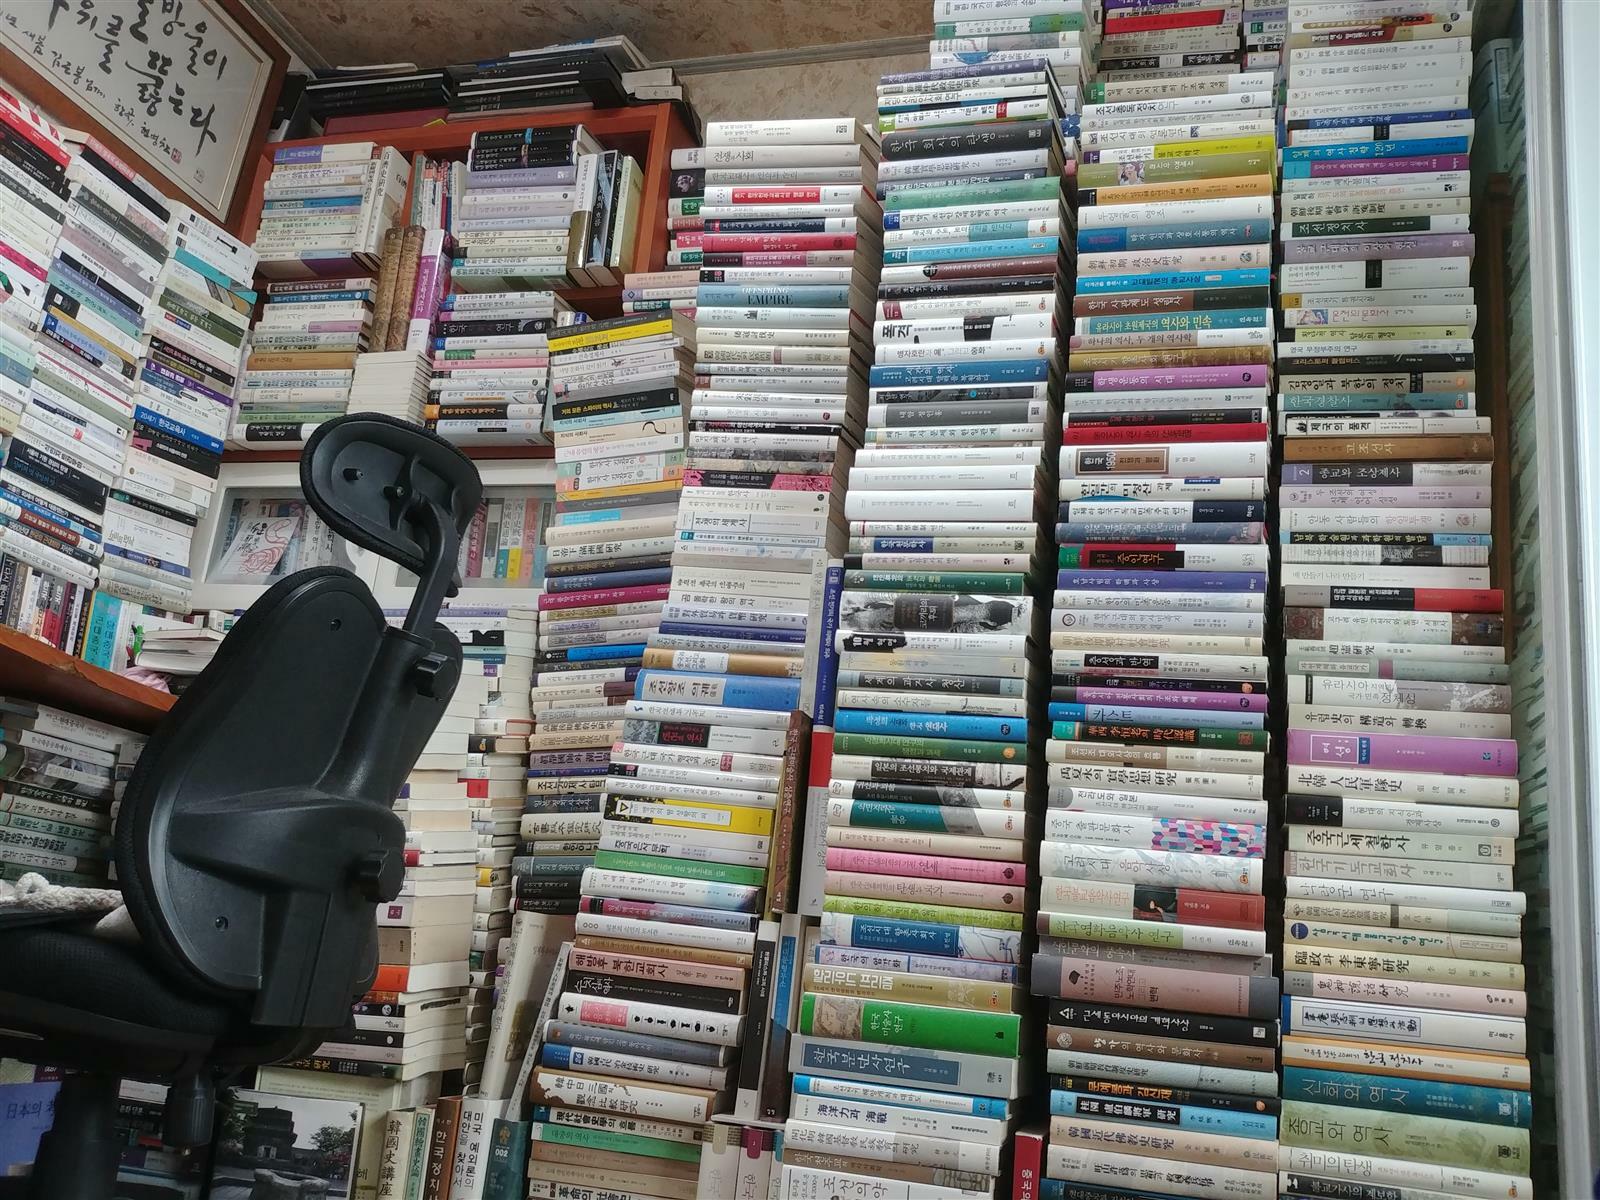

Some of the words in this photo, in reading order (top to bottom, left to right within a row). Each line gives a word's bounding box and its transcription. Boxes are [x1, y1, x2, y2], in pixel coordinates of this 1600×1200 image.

[736, 151, 754, 162] 사회
[1300, 221, 1368, 234] 조선정치사
[748, 295, 794, 305] EMPIRE
[1095, 322, 1122, 333] 유라시아
[1125, 319, 1158, 330] 초원제국의
[1161, 317, 1190, 330] 역사와
[1193, 315, 1212, 329] 민속
[1088, 337, 1112, 346] 하나의
[1115, 335, 1134, 345] 역사,
[1136, 335, 1144, 344] 두
[1148, 334, 1165, 343] 개의
[1167, 334, 1192, 343] 역사학
[1289, 379, 1336, 391] 김정일과
[1341, 378, 1377, 389] 북한의
[1382, 377, 1408, 388] 정치
[158, 417, 186, 436] 한국교육사
[1311, 422, 1344, 432] 제국의
[1348, 422, 1372, 431] 품격
[1346, 442, 1396, 455] 고조선사
[1106, 451, 1116, 471] 1950
[1319, 467, 1353, 478] 종교와
[1356, 467, 1400, 479] 조상제사
[865, 677, 896, 686] 세계의
[904, 677, 938, 687] 과거사
[942, 679, 966, 689] 청산
[1093, 709, 1134, 722] 카스트
[925, 722, 948, 732] 현대사
[874, 762, 897, 772] 일본의
[1051, 819, 1073, 829] 중국
[1307, 829, 1411, 852] 중국근세철학사
[1063, 855, 1112, 870] 고려시대
[924, 886, 944, 895] 국가
[1359, 889, 1394, 902] 연구
[1149, 929, 1174, 943] 연구
[576, 954, 608, 969] 해방후
[612, 960, 669, 977] 북한교회사
[841, 954, 869, 965] 한국의
[1295, 951, 1334, 966] 臨政과
[814, 969, 858, 986] 할리우드
[860, 975, 894, 991] 프리즘
[894, 1015, 904, 1034] 연구
[1082, 1010, 1099, 1022] 근세
[1103, 1011, 1148, 1025] 동아시아의
[1151, 1016, 1190, 1032] 개혁사상
[813, 1048, 912, 1074] 한국분단사연구
[1363, 1050, 1387, 1066] 한국
[1389, 1054, 1424, 1068] 정치사
[1088, 1082, 1134, 1096] 문예봉과
[1137, 1087, 1173, 1100] 김신재
[1302, 1079, 1362, 1101] 신화와
[1369, 1086, 1410, 1106] 역사
[817, 1104, 861, 1120] 海洋力과
[865, 1111, 888, 1124] 海戰
[460, 1111, 472, 1146] 대안을
[472, 1113, 483, 1135] 미국
[1289, 1117, 1346, 1141] 종교와
[1353, 1123, 1393, 1147] 역사
[380, 1120, 402, 1196] 韓國史講座
[494, 1149, 508, 1157] 002
[453, 1152, 466, 1187] 찾아서
[465, 1142, 479, 1189] 예외론의
[1344, 1157, 1373, 1177] 탄생
